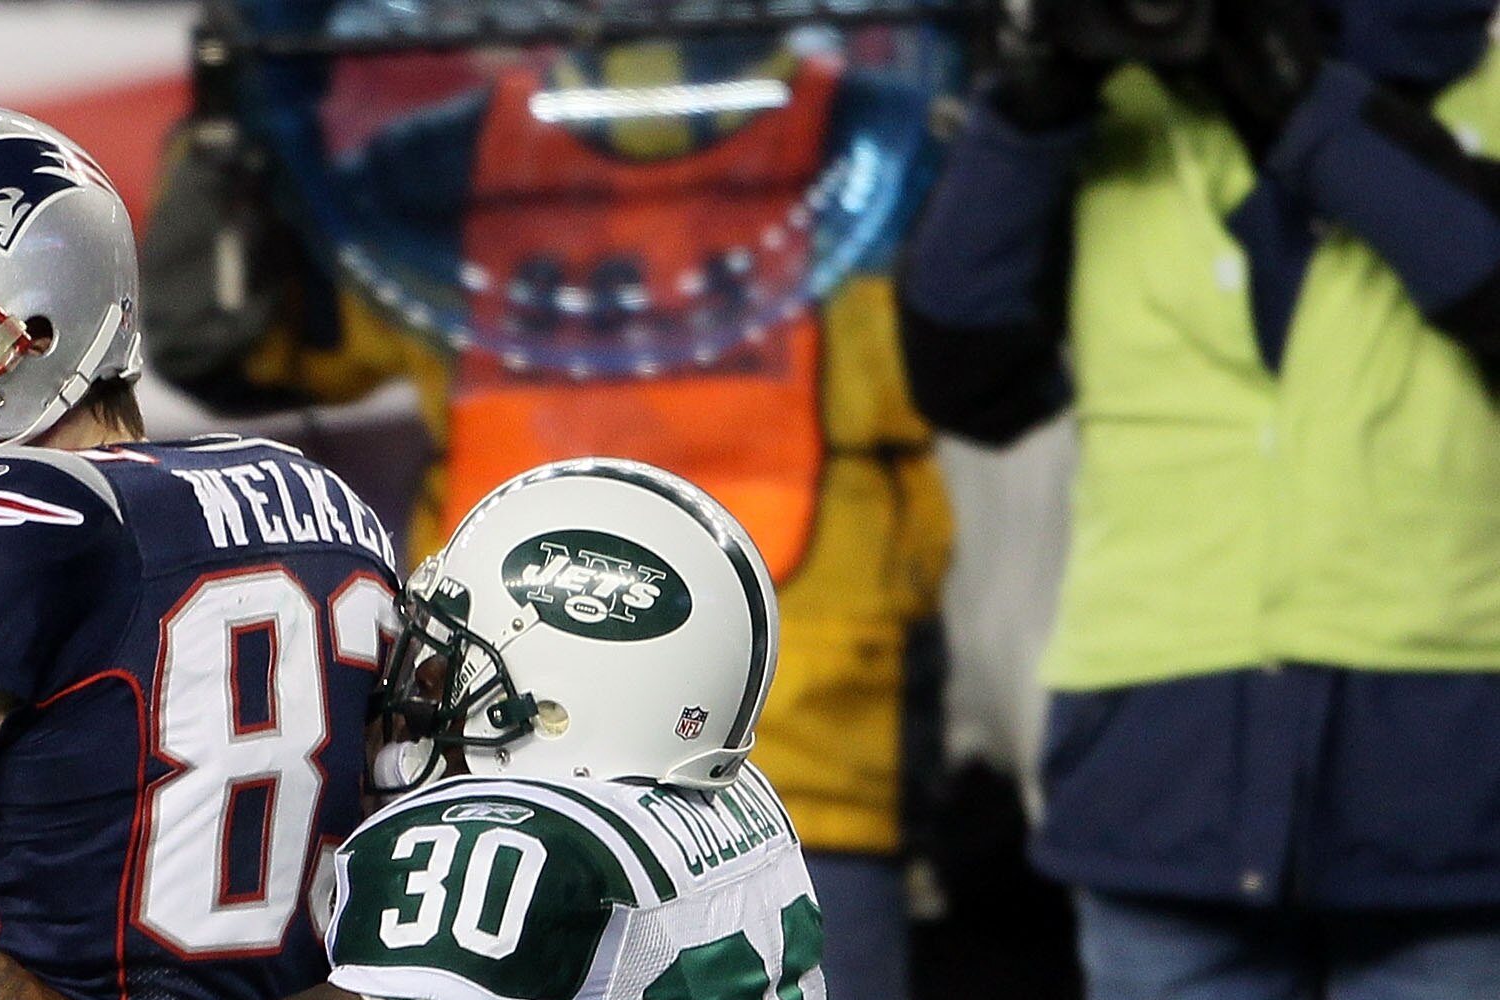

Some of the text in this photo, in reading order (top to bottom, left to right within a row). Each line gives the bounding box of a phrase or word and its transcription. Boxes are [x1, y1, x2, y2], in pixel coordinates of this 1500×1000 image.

[438, 578, 465, 599] NY
[522, 555, 661, 609] JETS
[379, 825, 548, 960] 30
